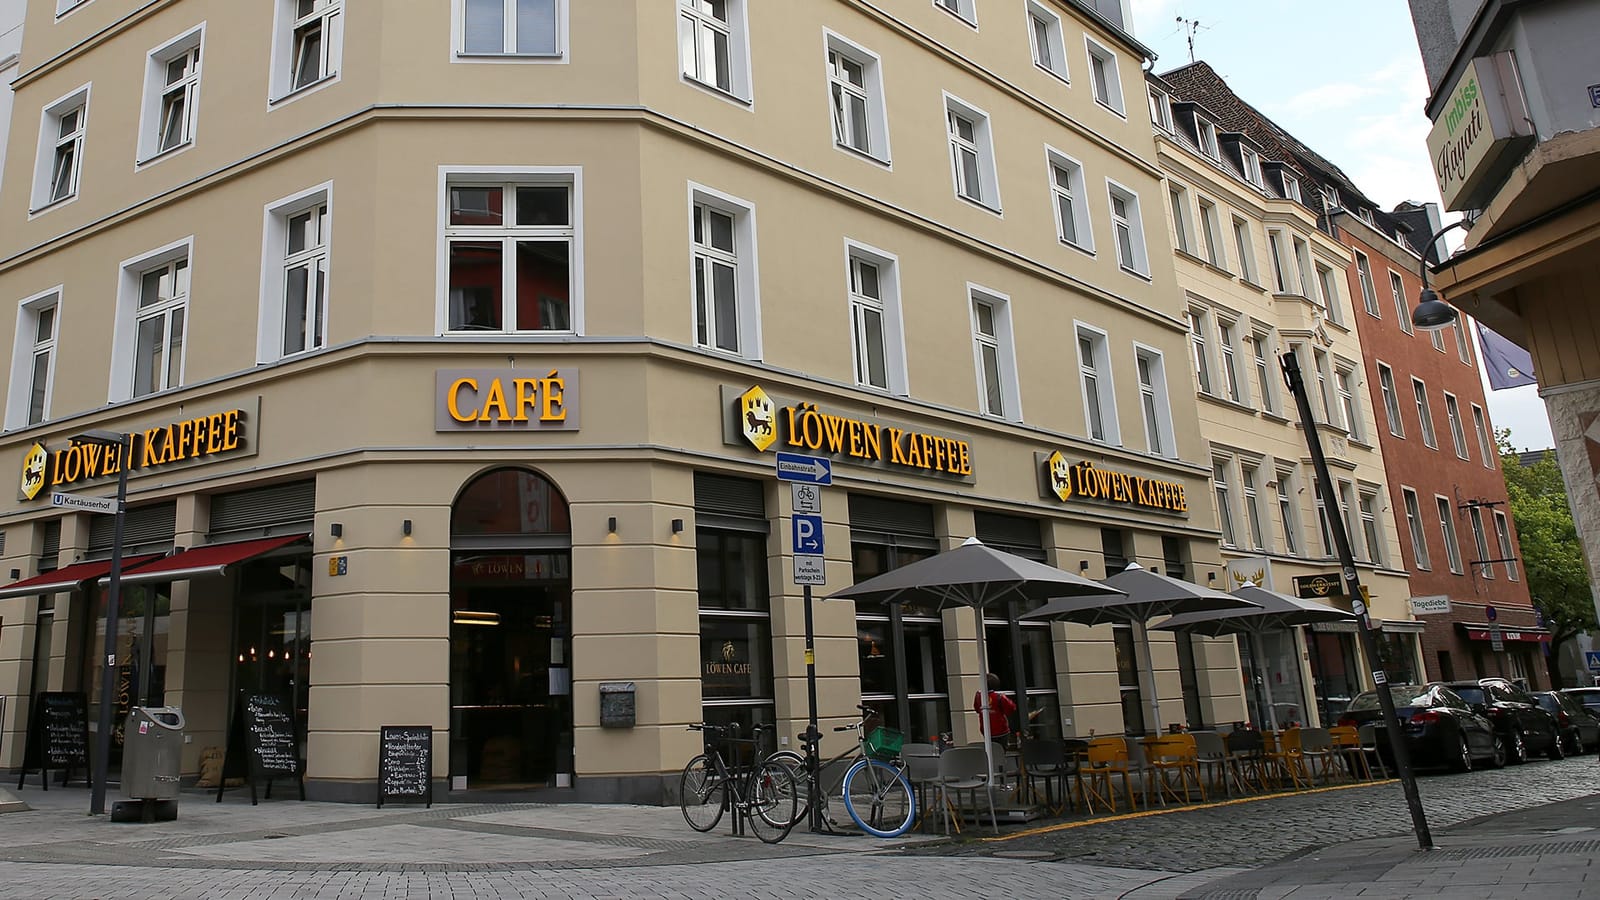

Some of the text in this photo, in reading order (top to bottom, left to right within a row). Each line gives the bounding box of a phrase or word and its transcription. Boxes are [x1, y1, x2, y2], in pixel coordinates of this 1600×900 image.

[1444, 79, 1477, 136] Imbiss
[1437, 98, 1482, 192] Hayati
[447, 368, 568, 422] CAFÉ
[141, 409, 240, 467] KAFFEE
[785, 402, 972, 476] LÖWEN KAFFEE
[780, 462, 817, 473] Einbahnstraße
[1075, 461, 1189, 512] LÖWEN KAFFEE
[64, 497, 111, 509] Kartäuserhof
[797, 519, 814, 549] P
[706, 661, 732, 674] LÖWEN
